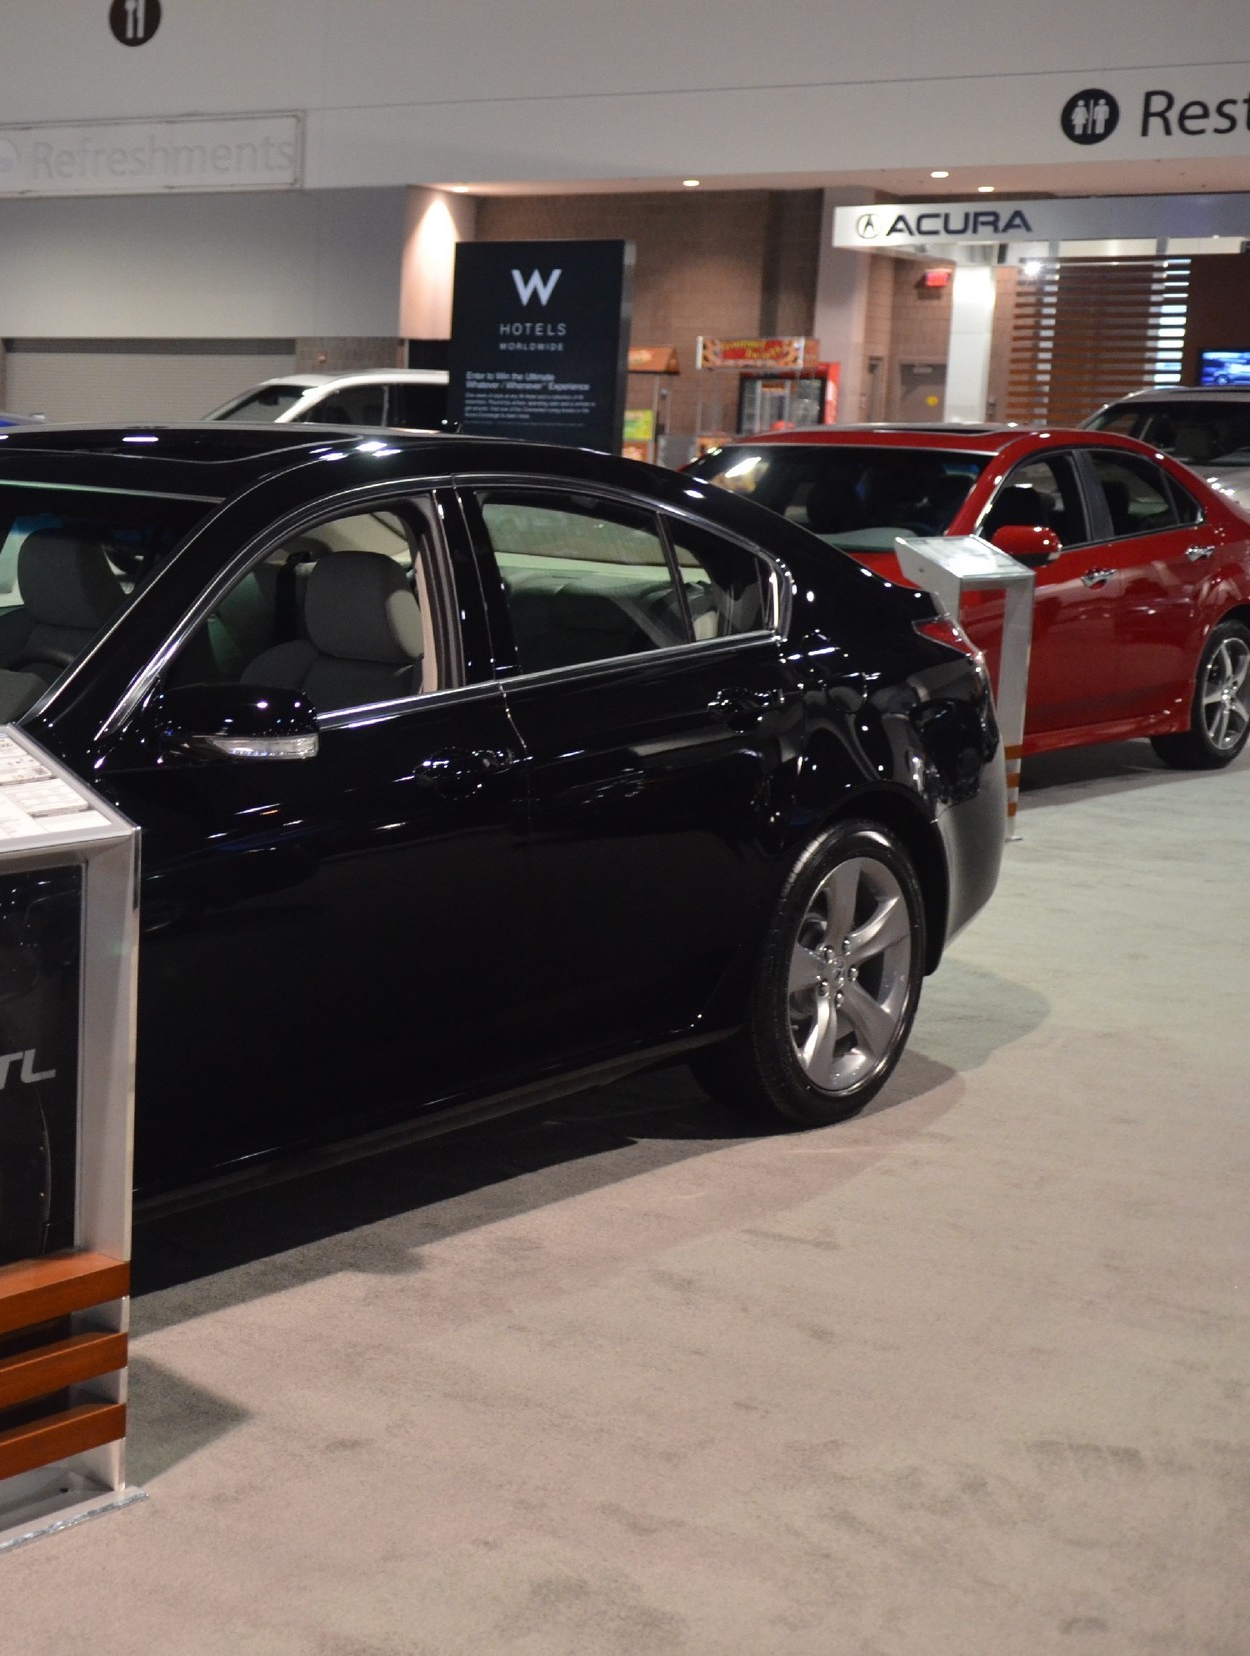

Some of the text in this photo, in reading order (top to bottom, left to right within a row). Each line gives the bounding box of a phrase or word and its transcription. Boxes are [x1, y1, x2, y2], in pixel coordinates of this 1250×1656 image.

[30, 135, 296, 180] Refreshments
[886, 210, 1033, 237] ACURA
[511, 268, 562, 307] W
[499, 323, 567, 336] HOTELS
[499, 342, 564, 351] WORLDWIDE
[511, 372, 524, 381] the
